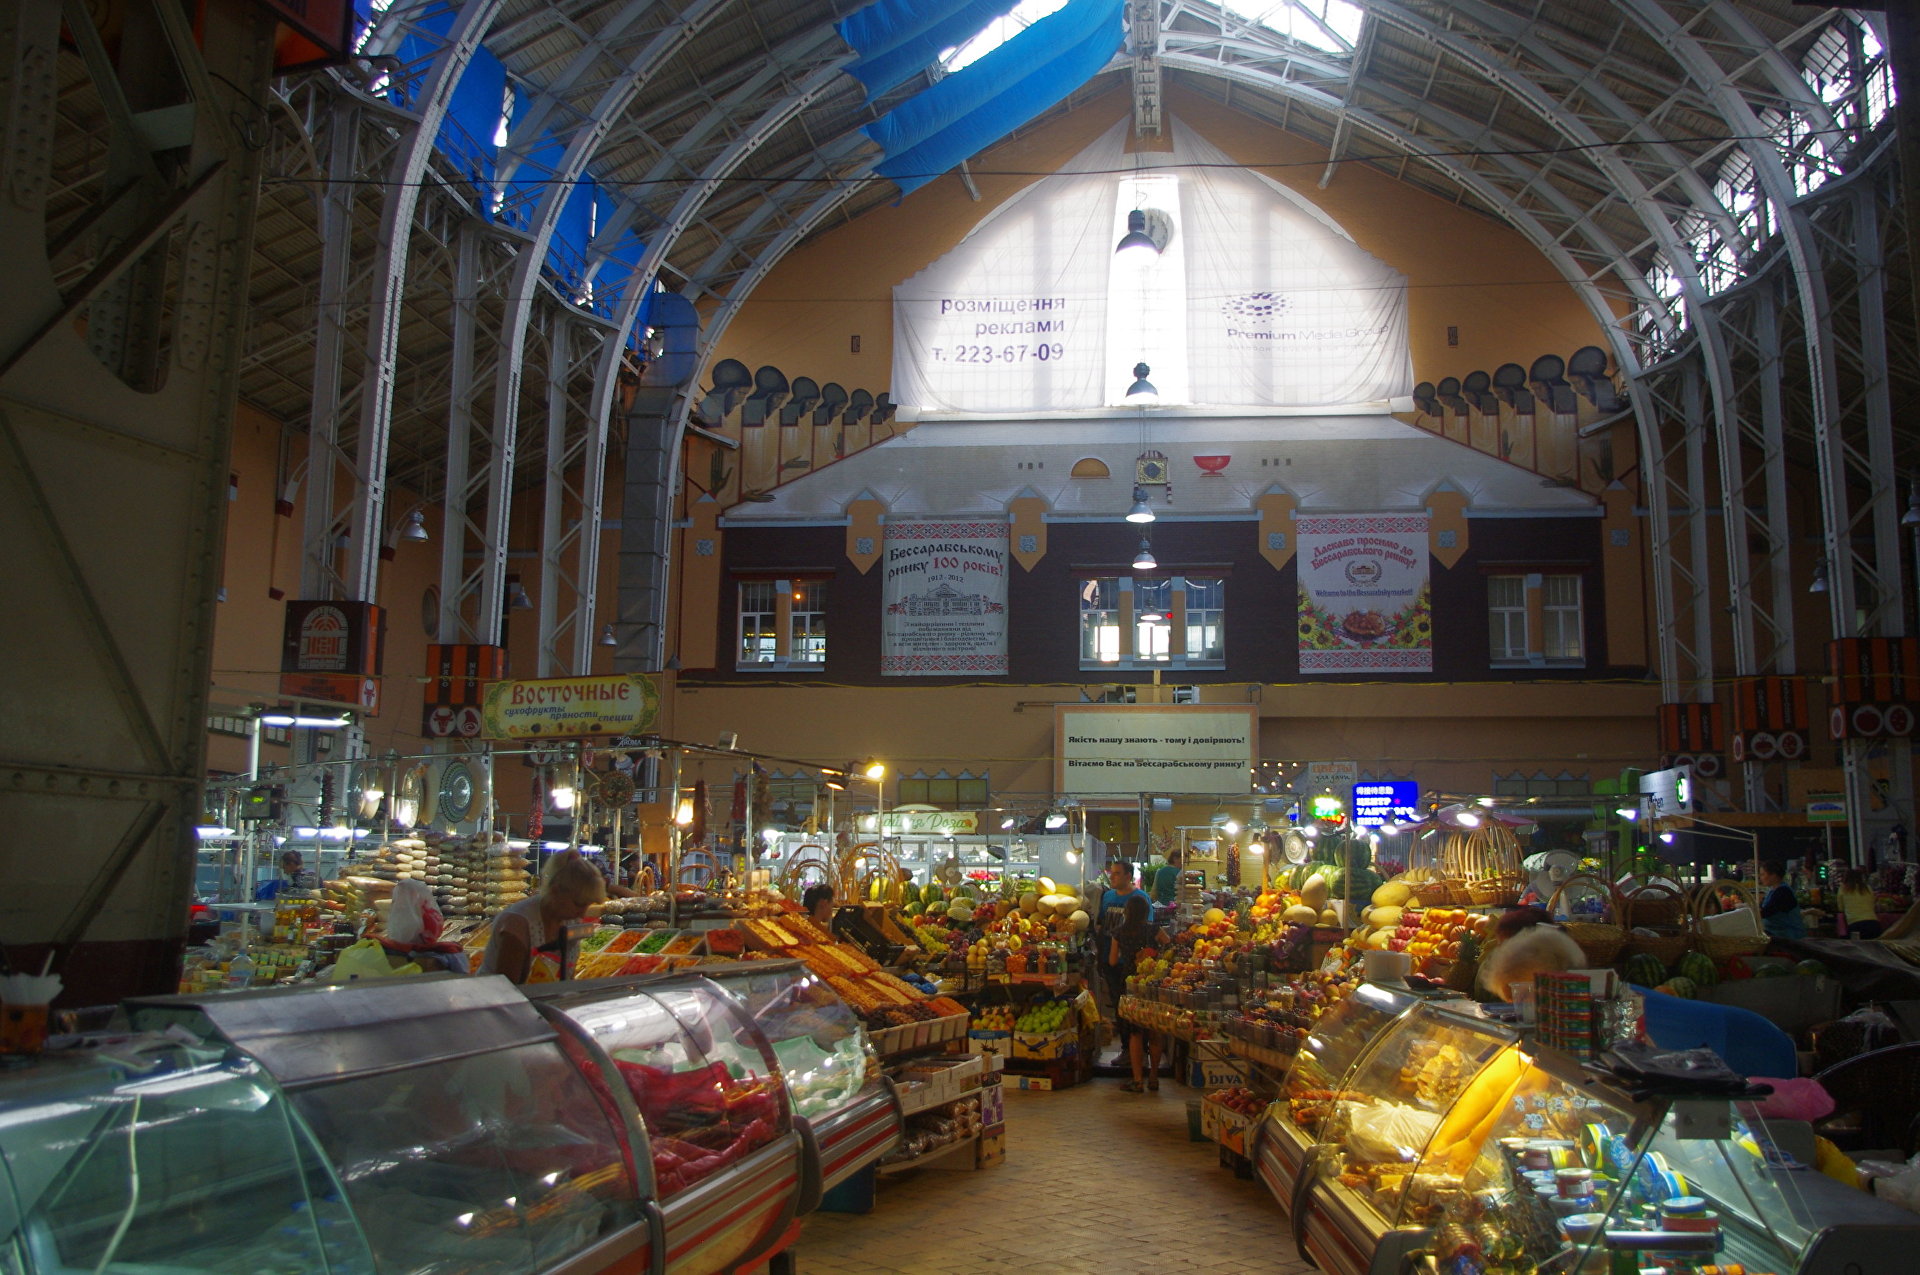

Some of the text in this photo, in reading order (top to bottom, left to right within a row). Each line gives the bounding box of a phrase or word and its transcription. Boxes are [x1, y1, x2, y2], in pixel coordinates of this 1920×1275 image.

[941, 296, 1065, 314] розміщення
[976, 319, 1065, 338] реклами
[1227, 328, 1296, 340] Premium
[931, 342, 1064, 363] т. 223-67-09
[1313, 537, 1414, 558] Ласкаво просимо до
[888, 556, 1004, 582] ринку 100 років!
[504, 705, 566, 717] сухофрукты
[550, 711, 598, 721] пряности
[598, 713, 634, 723] специи
[1068, 736, 1098, 744] Якість
[1099, 737, 1123, 745] нашу
[1164, 737, 1186, 745] тому
[1192, 736, 1245, 745] довіряють!
[1068, 759, 1104, 767] Вітаємо
[1105, 759, 1122, 767] Вас
[1136, 759, 1212, 769] Бессарабському
[1213, 759, 1245, 769] ринку!
[928, 813, 966, 832] Роза
